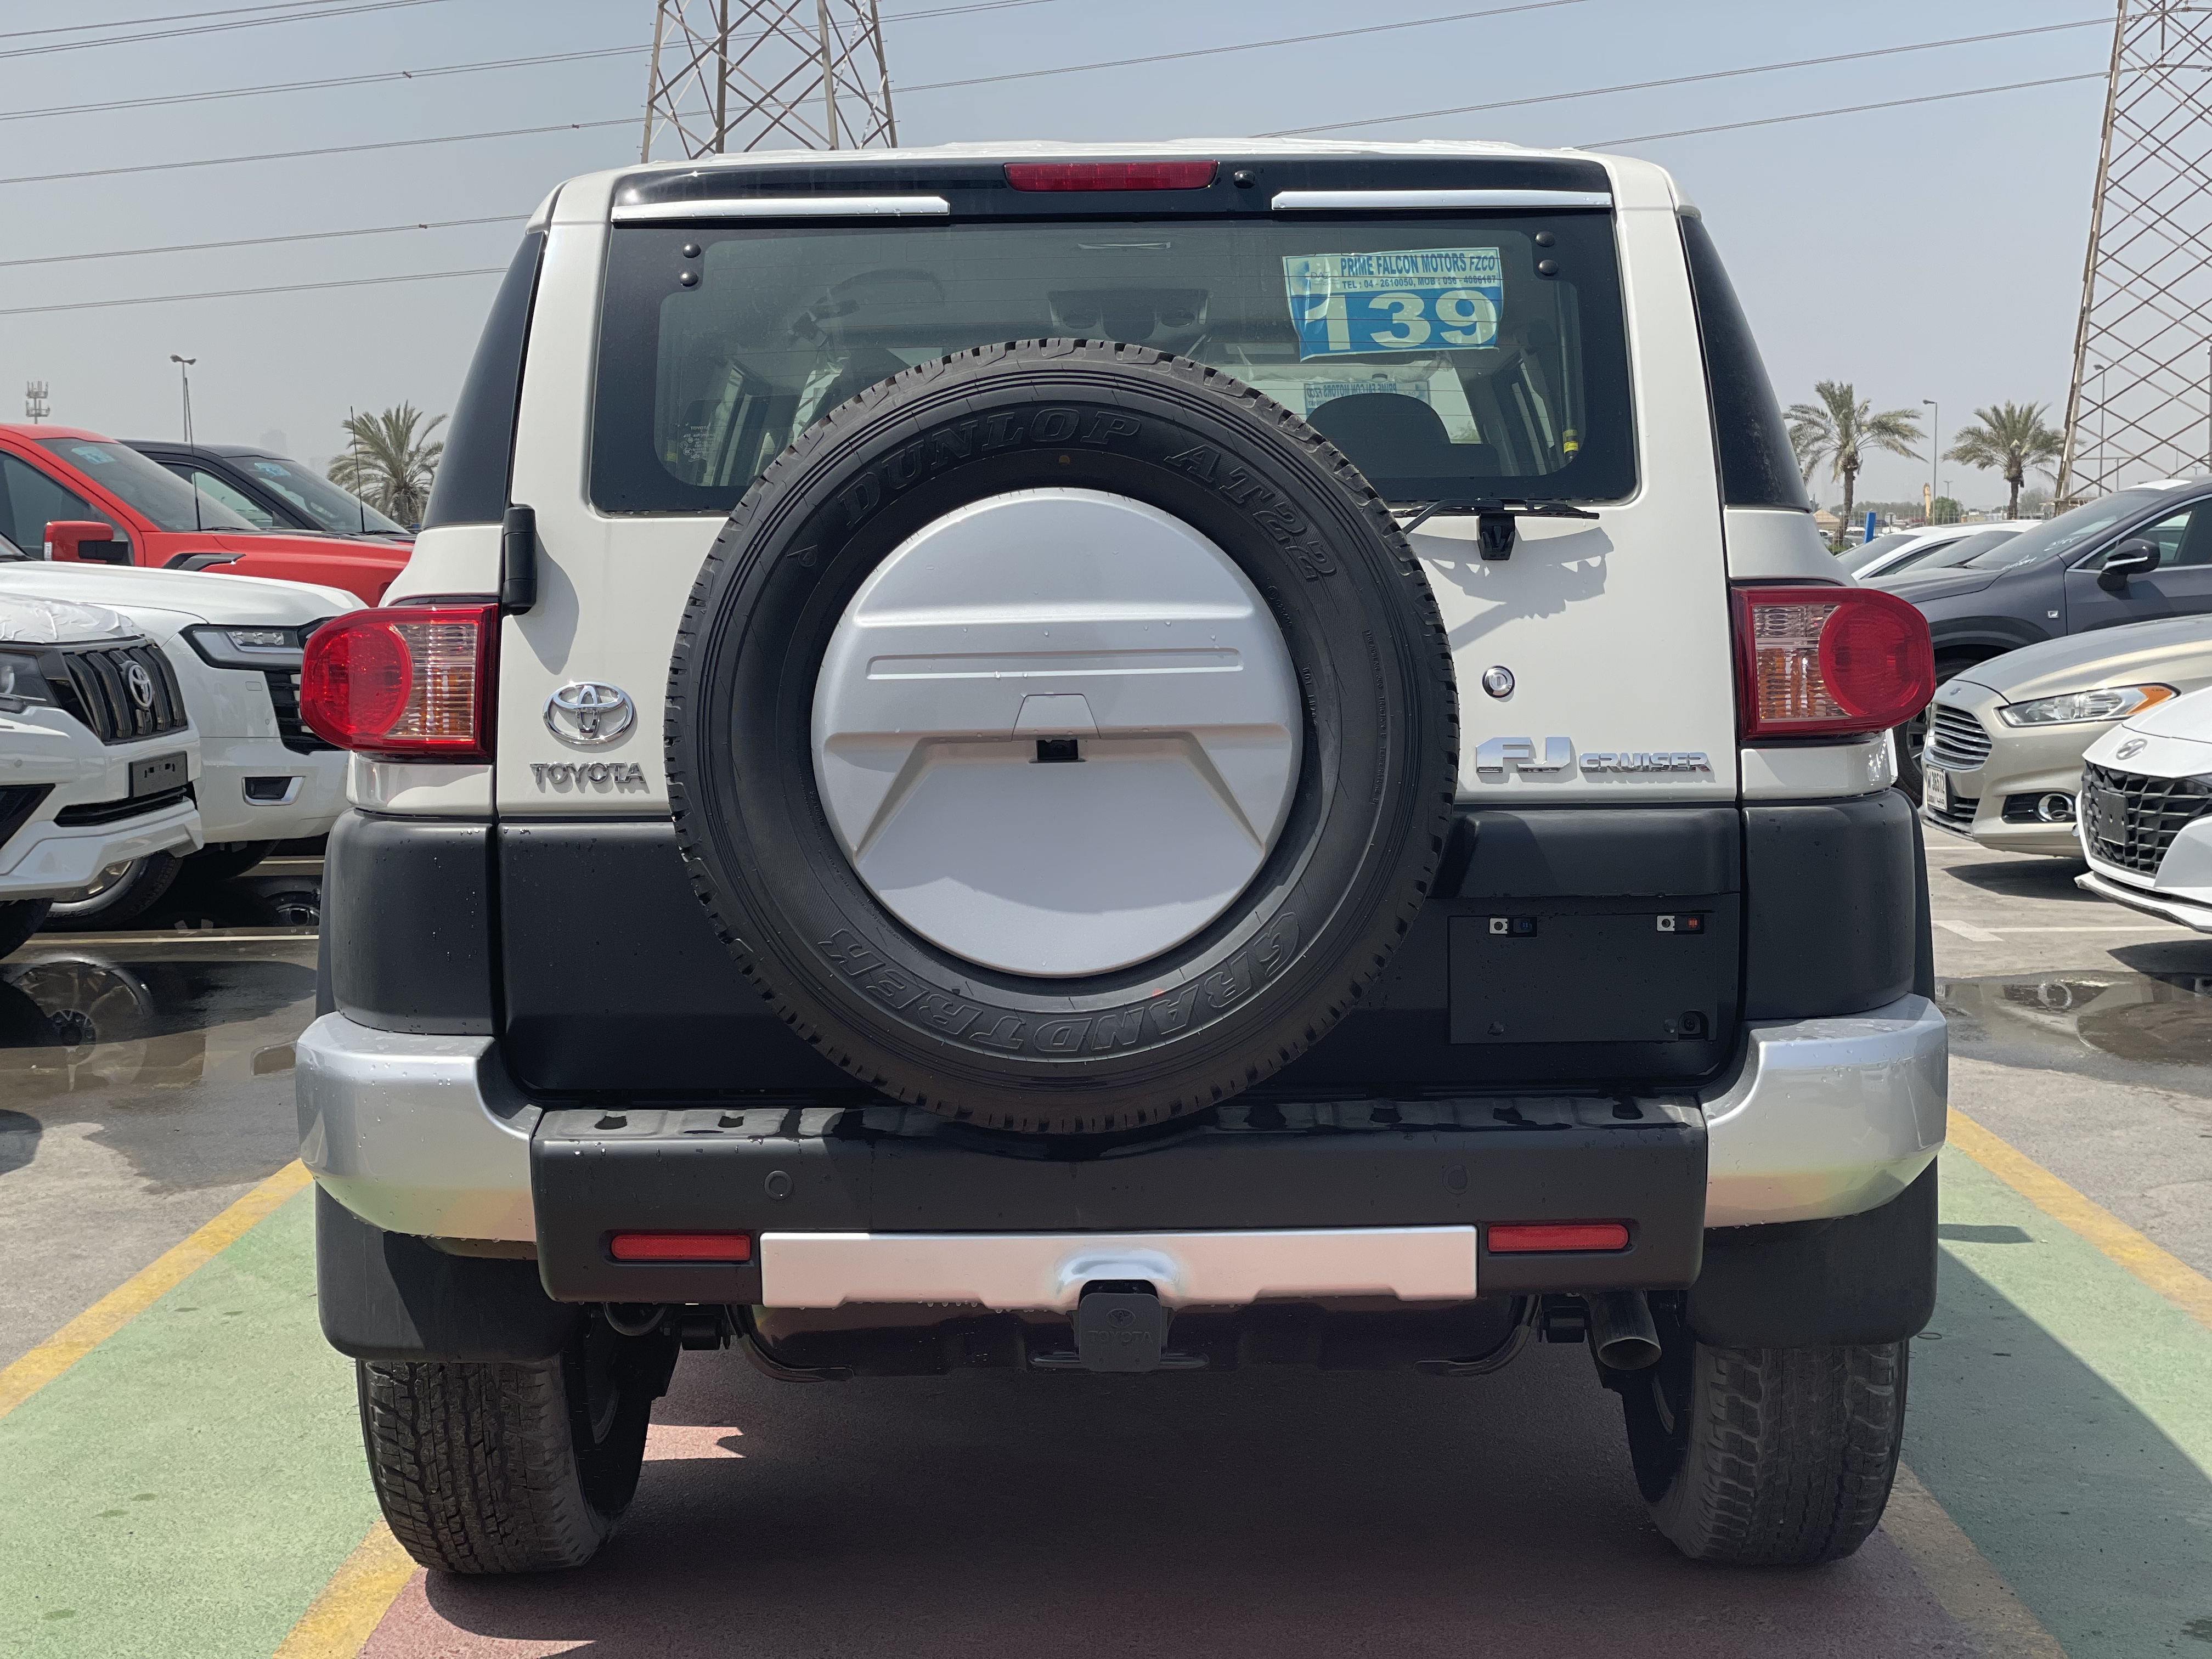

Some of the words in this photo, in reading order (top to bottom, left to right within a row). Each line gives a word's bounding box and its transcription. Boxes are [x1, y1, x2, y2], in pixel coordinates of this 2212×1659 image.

[1340, 256, 1374, 277] PRIME
[1376, 255, 1419, 275] FALCON
[1421, 252, 1466, 273] MOTORS
[1469, 255, 1495, 272] FZCO
[1342, 280, 1357, 289] TEL
[1364, 280, 1373, 288] 04
[1418, 277, 1436, 286] MOB
[1305, 290, 1497, 351] 139
[837, 407, 1142, 530] DUNLOP
[1164, 443, 1337, 582] AT22
[1476, 736, 1571, 774] FJ
[1579, 752, 1711, 772] CRUISER
[529, 761, 646, 783] TOYOTA
[819, 911, 1301, 1053] GRANDTREK
[1087, 1330, 1153, 1346] TOYOTA
